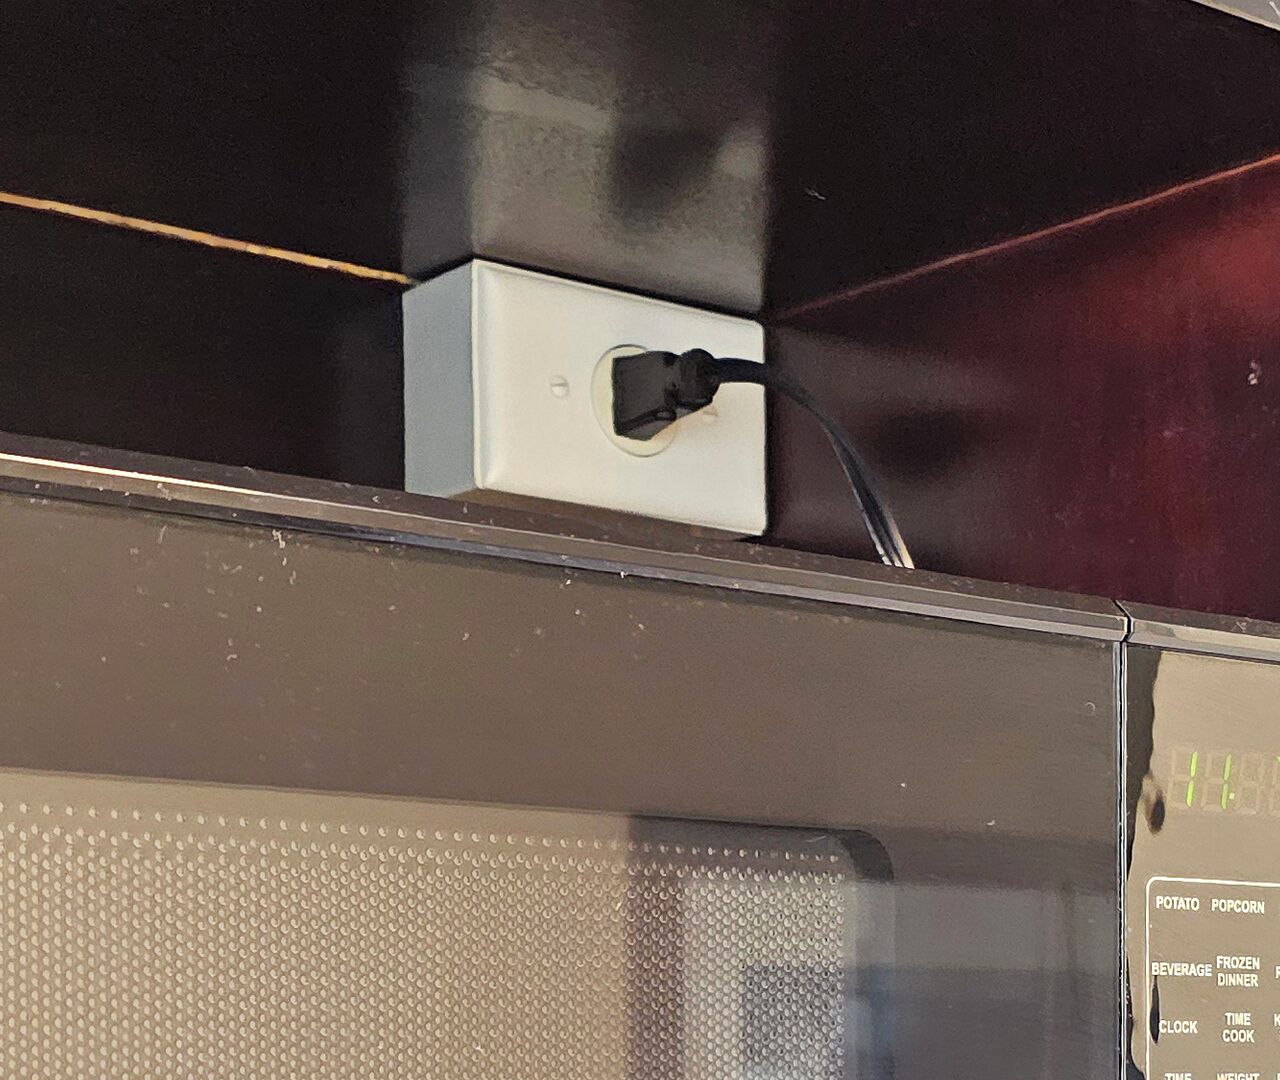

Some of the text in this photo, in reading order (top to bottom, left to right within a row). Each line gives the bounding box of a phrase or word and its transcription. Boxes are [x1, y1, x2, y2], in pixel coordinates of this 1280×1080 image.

[1156, 896, 1199, 911] POTATO
[1211, 899, 1265, 914] POPCORN
[1151, 962, 1212, 977] BEVERAGE
[1216, 955, 1260, 970] FROZEN
[1217, 973, 1258, 987] DINNER
[1225, 1012, 1251, 1025] TIME
[1159, 1020, 1198, 1034] CLOCK
[1222, 1030, 1254, 1043] COOK
